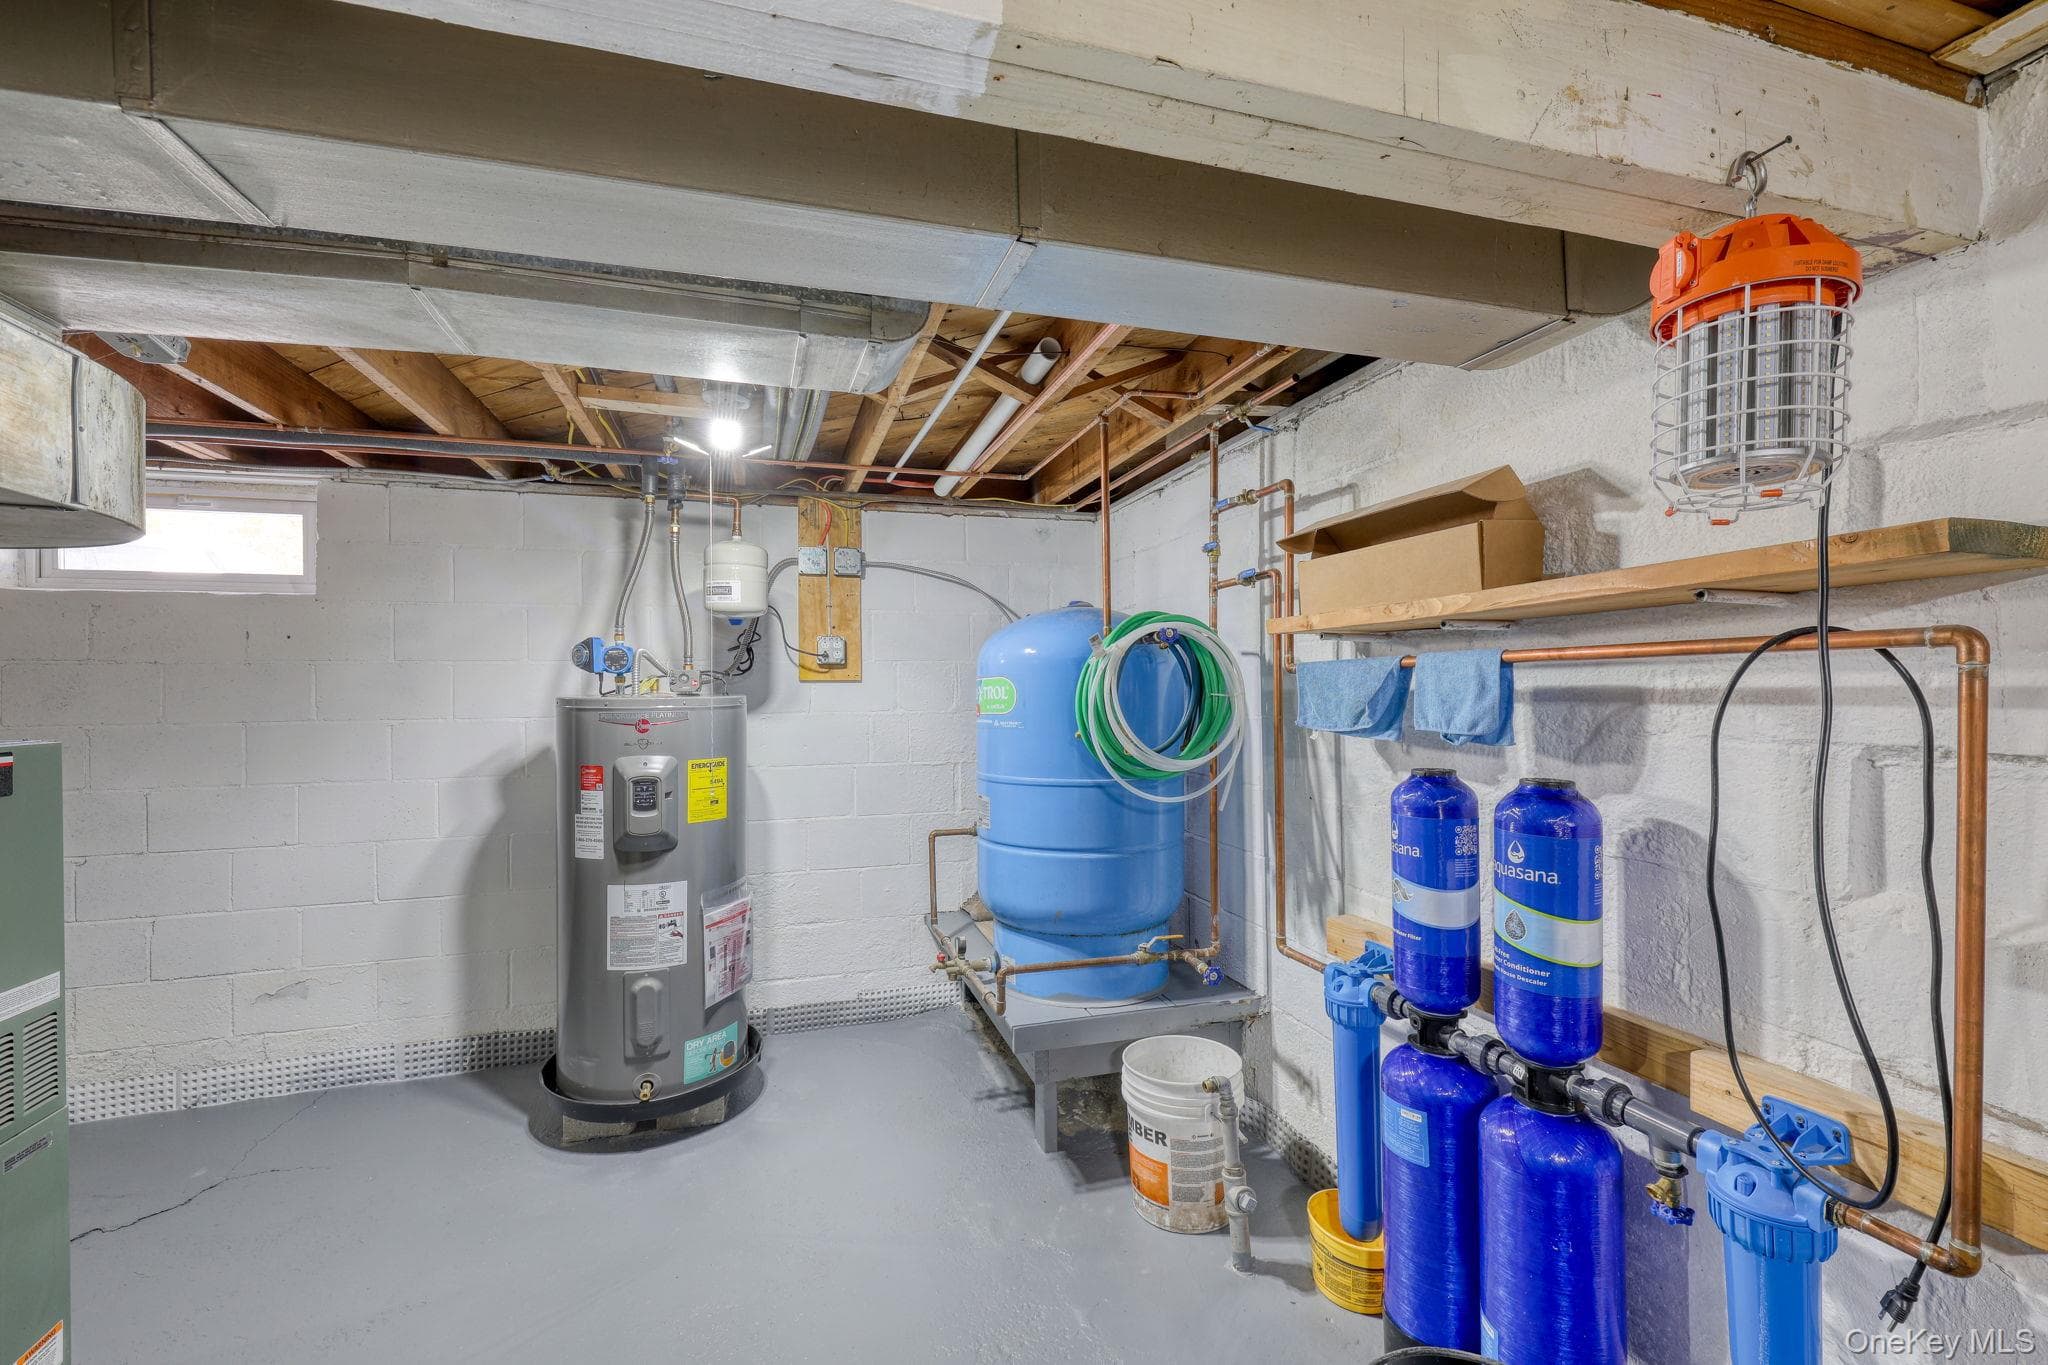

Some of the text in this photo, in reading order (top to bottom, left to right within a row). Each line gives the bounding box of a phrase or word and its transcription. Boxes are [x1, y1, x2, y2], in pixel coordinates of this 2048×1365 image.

[1503, 959, 1551, 978] Conditioner
[1516, 974, 1548, 987] Descaler
[686, 1030, 727, 1051] DRY AREA
